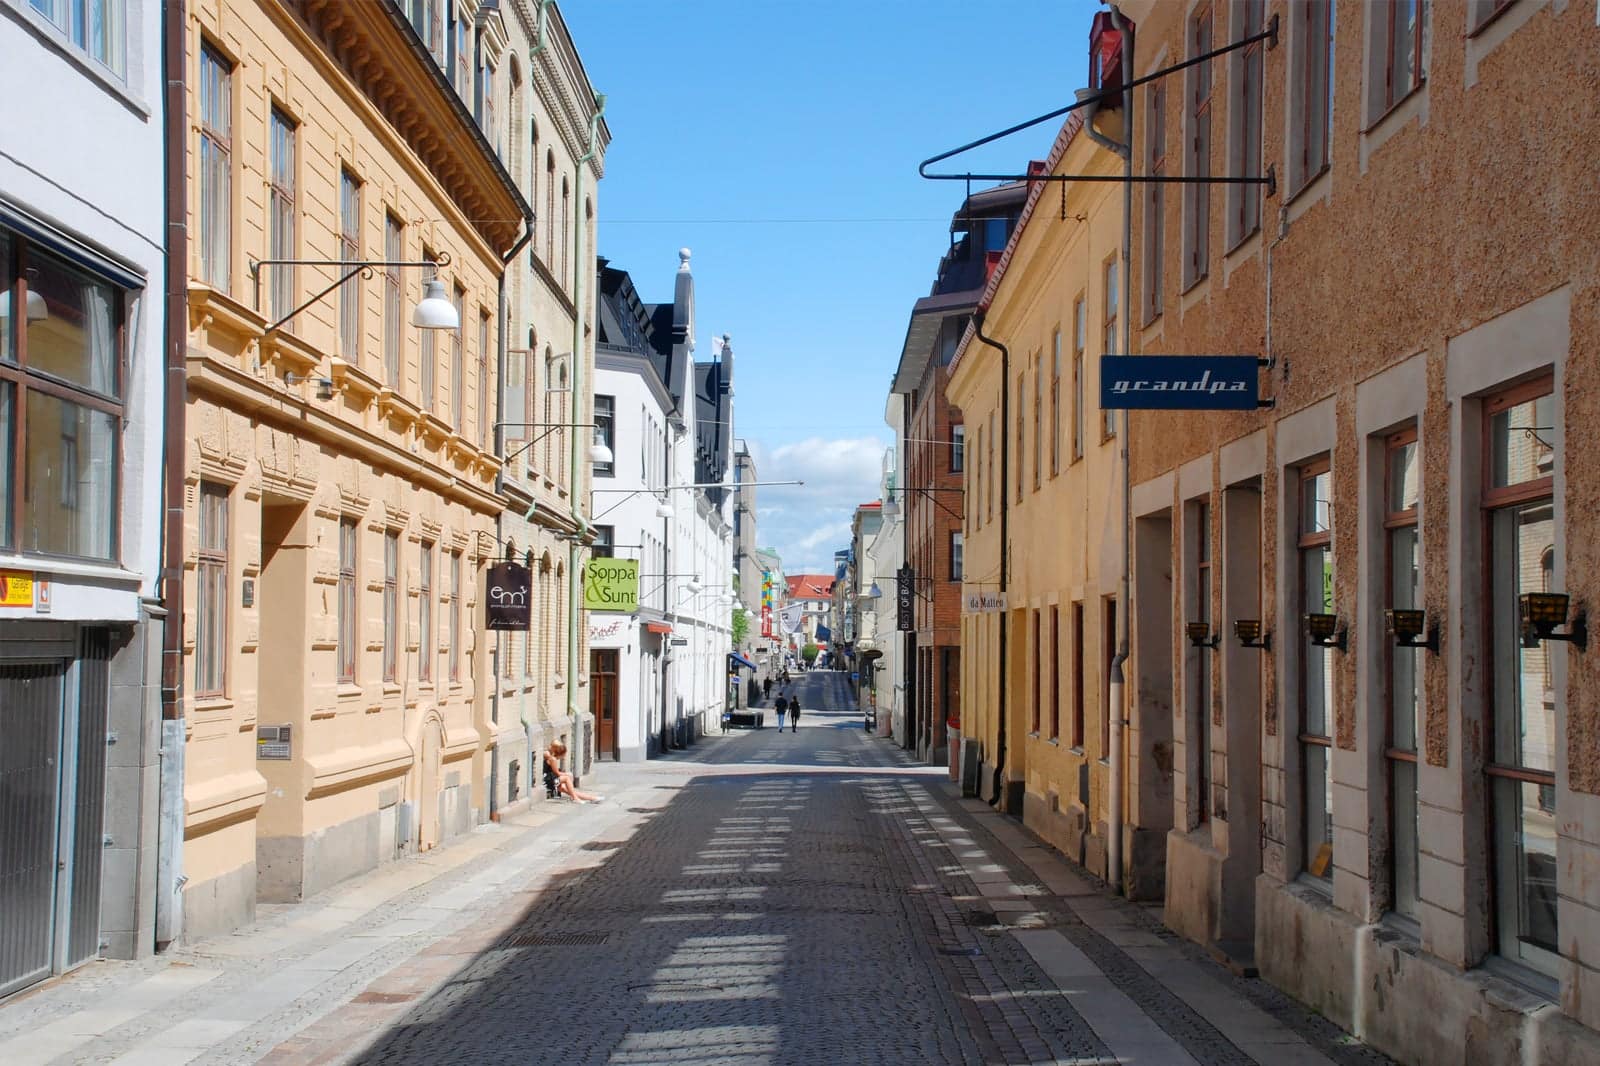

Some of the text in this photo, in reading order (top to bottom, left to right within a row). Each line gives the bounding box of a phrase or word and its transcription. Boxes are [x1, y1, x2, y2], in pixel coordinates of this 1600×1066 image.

[1110, 370, 1248, 394] grandpa
[588, 563, 636, 584] Soppa
[602, 585, 636, 603] Sunt
[901, 595, 910, 608] OF
[901, 609, 910, 629] BEST
